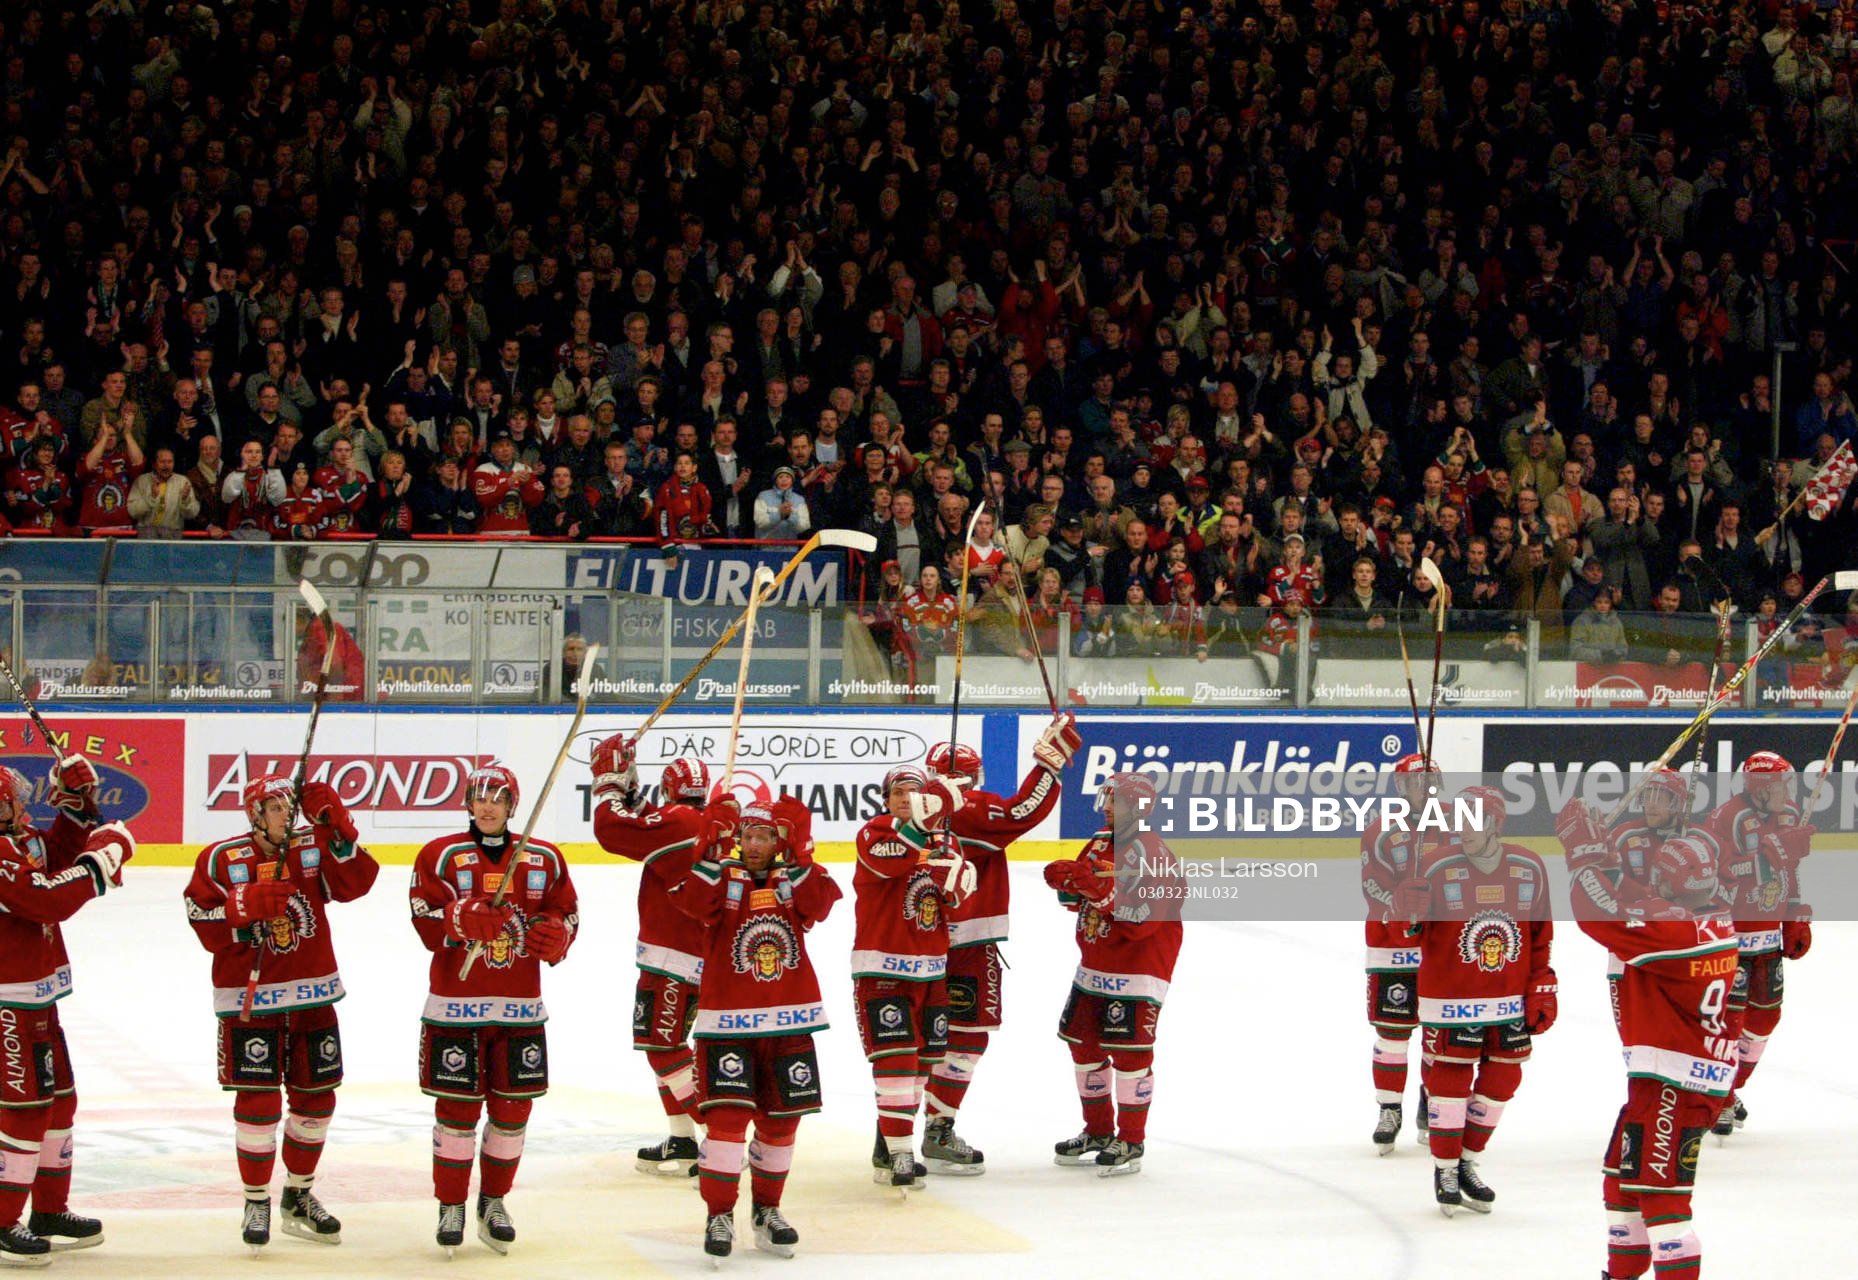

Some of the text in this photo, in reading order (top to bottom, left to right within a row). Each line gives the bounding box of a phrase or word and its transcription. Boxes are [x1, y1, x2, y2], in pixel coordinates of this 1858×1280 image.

[56, 683, 128, 695] baldursson
[171, 685, 272, 700] skyltbutiken.com
[716, 680, 791, 695] balursson
[828, 680, 940, 698] skyltbutiken.com
[1077, 682, 1184, 699] skyltbutiken.com
[1212, 685, 1281, 698] baldursson
[1545, 685, 1643, 700] skyltbutiken.com
[50, 730, 137, 766] MEX
[660, 733, 714, 758] DÄR
[850, 735, 906, 758] ONT
[1010, 771, 1054, 820] BROTHERS
[883, 957, 923, 973] SKF
[1392, 951, 1420, 965] SK
[297, 977, 340, 1000] SKF
[984, 944, 997, 1019] ALMOND
[1092, 975, 1130, 991] SKF
[1535, 984, 1558, 994] ITE
[35, 982, 54, 998] SK
[445, 1002, 543, 1018] SKF SKF
[656, 976, 681, 1042] ALMON
[1441, 1004, 1487, 1019] SKF
[718, 1006, 824, 1029] SKF SKF
[1690, 1061, 1731, 1083] SKF
[1648, 1083, 1678, 1179] ALMOND
